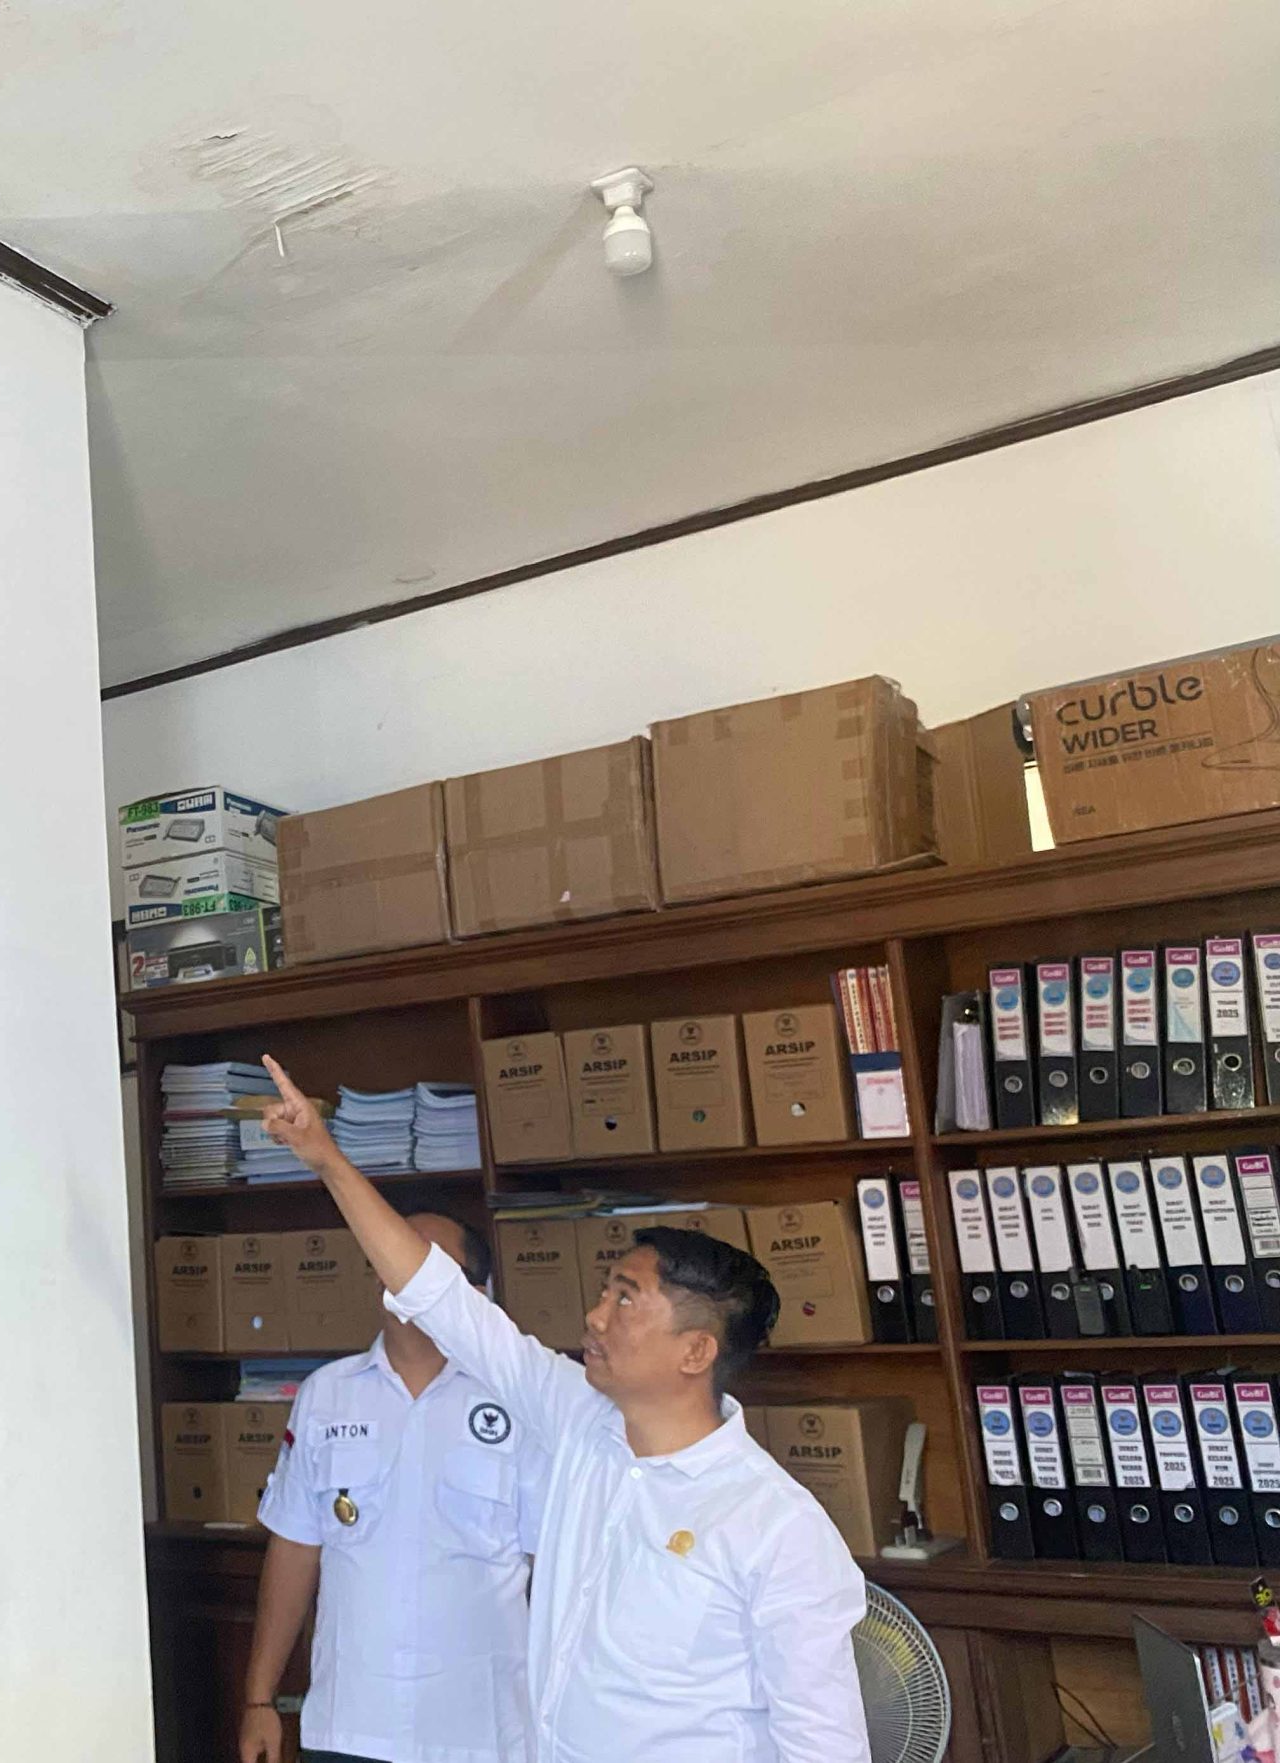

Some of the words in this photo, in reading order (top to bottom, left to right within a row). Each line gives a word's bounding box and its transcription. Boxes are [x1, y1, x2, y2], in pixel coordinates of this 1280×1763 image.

[1056, 674, 1204, 726] curble
[1062, 719, 1159, 754] WIDER
[127, 801, 159, 818] FT-983
[183, 901, 216, 916] FT-983
[765, 1041, 816, 1056] ARSIP
[670, 1050, 718, 1063] ARSIP
[499, 1064, 543, 1079] ARSIP
[582, 1059, 627, 1073] ARSIP
[771, 1236, 822, 1252] ARSIP
[517, 1250, 560, 1262] ARSIP
[172, 1264, 208, 1275] ARSIP
[235, 1263, 272, 1274] ARSIP
[299, 1260, 337, 1272] ARSIP
[175, 1433, 211, 1444] ARSIP
[238, 1433, 274, 1442] ARSIP
[789, 1446, 842, 1459] ARSIP
[1164, 1462, 1187, 1471] 2025
[1123, 1476, 1146, 1486] 2025
[1213, 1477, 1235, 1486] 2025
